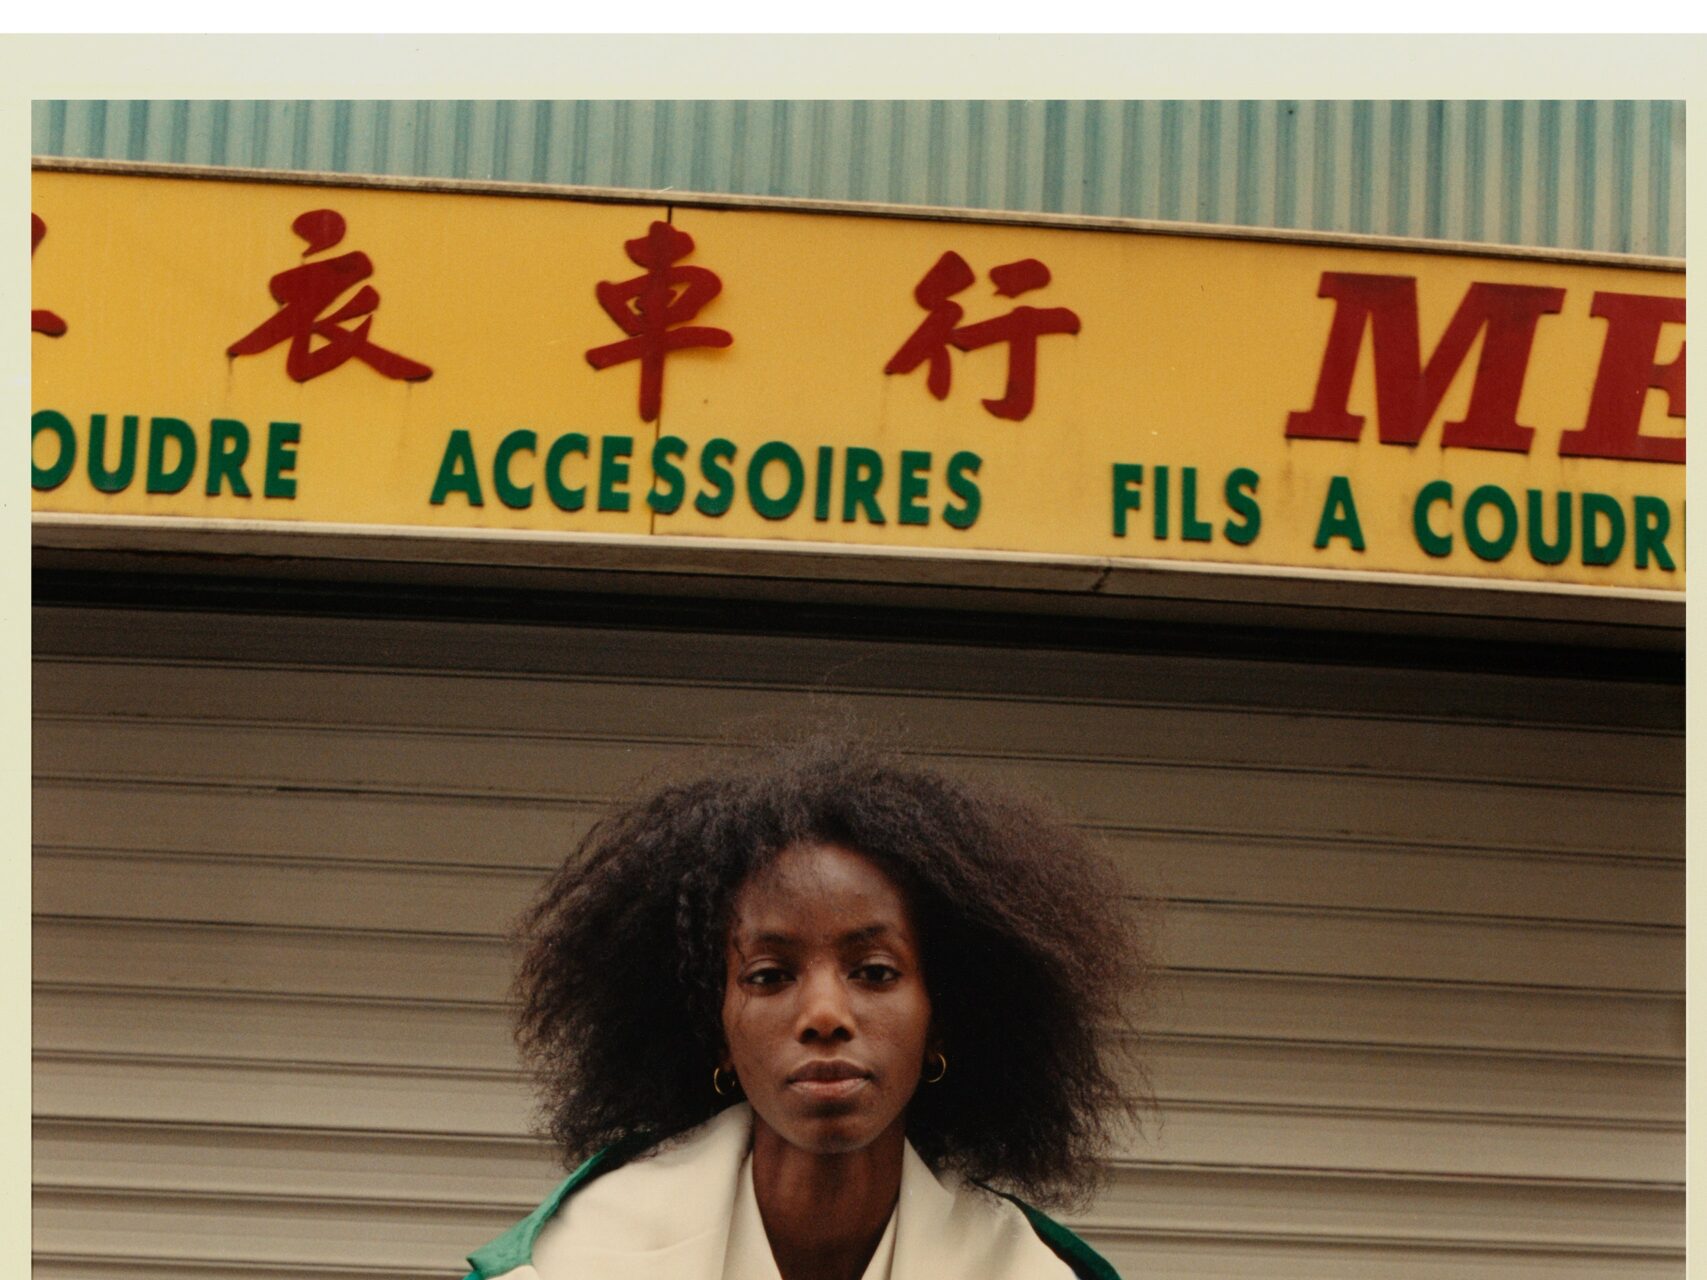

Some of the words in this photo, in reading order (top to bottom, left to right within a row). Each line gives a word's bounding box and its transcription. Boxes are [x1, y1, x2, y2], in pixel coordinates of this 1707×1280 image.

[1284, 271, 1686, 463] ME
[31, 410, 302, 500] OUDRE
[430, 429, 983, 530] ACCESSOIRES
[1111, 462, 1262, 546] FILS
[1315, 476, 1367, 551] A
[1413, 479, 1686, 572] COUDR
